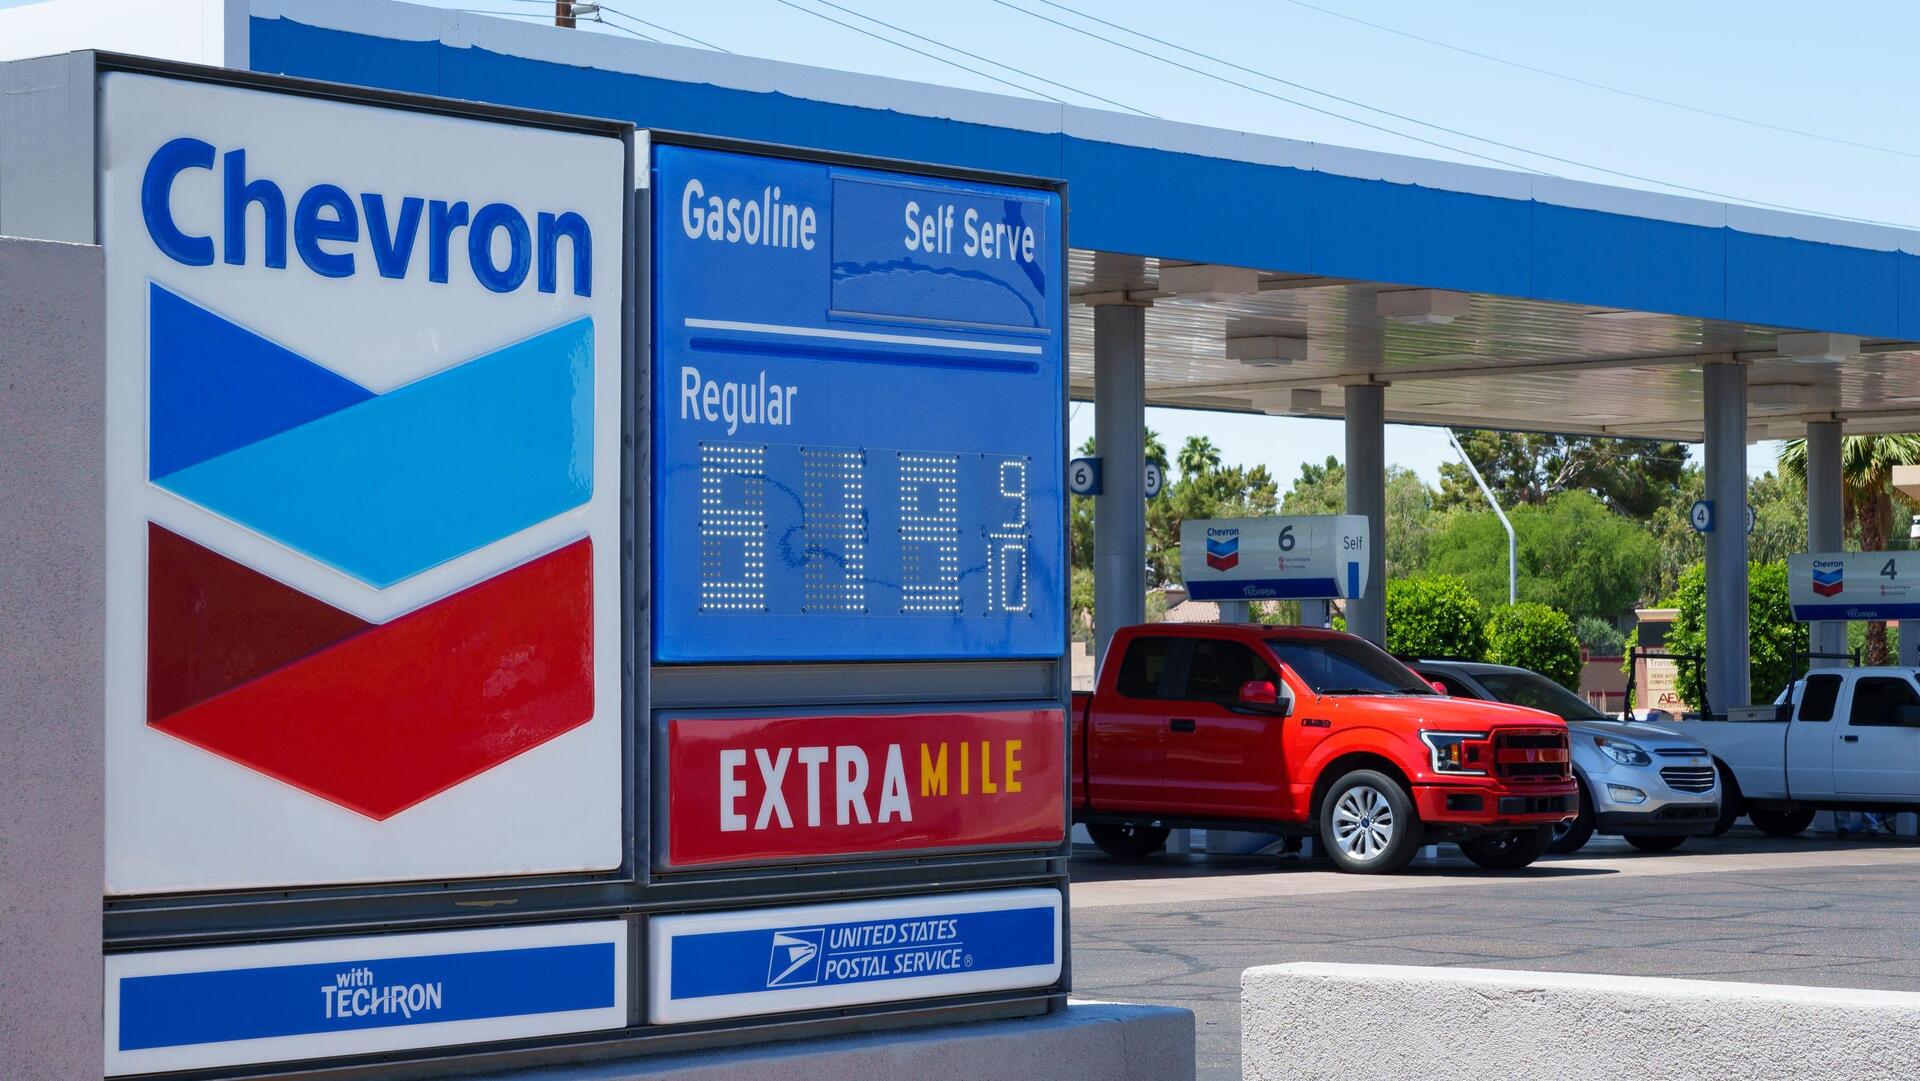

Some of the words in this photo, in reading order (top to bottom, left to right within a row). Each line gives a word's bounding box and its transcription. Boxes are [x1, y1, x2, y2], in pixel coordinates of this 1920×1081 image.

[141, 137, 593, 298] Chevron
[682, 178, 817, 251] Gasoline
[904, 201, 955, 255] Self
[964, 207, 1035, 263] Serve
[681, 366, 798, 436] Regular
[1075, 468, 1086, 485] 6
[1147, 471, 1155, 487] 5
[1697, 509, 1705, 523] 4
[1207, 528, 1239, 536] Chevron
[1278, 525, 1295, 551] 6
[1343, 536, 1363, 550] Self
[1813, 560, 1843, 568] Chevron
[1880, 559, 1897, 580] 4
[720, 743, 913, 832] EXTRA
[920, 740, 1023, 797] MILE
[829, 924, 897, 949] UNITED
[898, 919, 959, 943] STATES
[336, 967, 374, 988] with
[824, 956, 890, 981] POSTAL
[321, 982, 442, 1019] TECHRON
